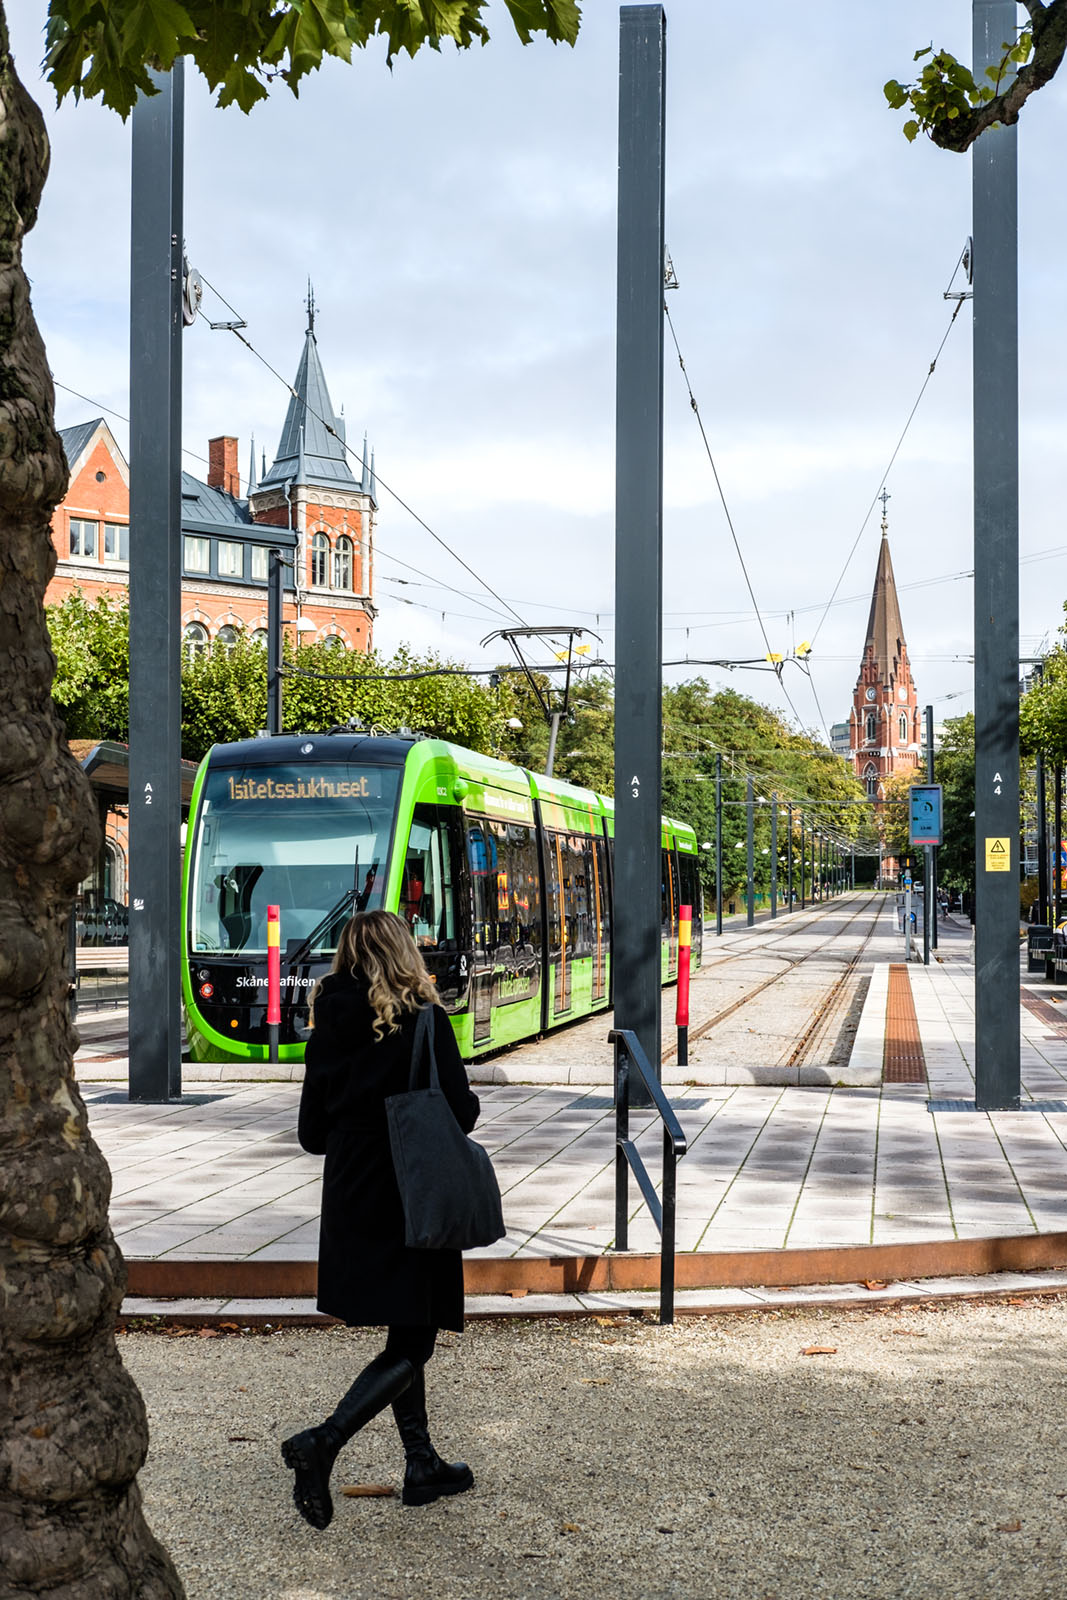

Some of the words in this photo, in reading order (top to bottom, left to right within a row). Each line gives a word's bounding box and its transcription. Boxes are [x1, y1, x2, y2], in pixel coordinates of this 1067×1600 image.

[631, 775, 640, 786] A
[993, 772, 1002, 782] A
[144, 782, 153, 792] A
[994, 785, 1002, 795] 4
[632, 788, 639, 798] 3
[145, 794, 152, 804] 2
